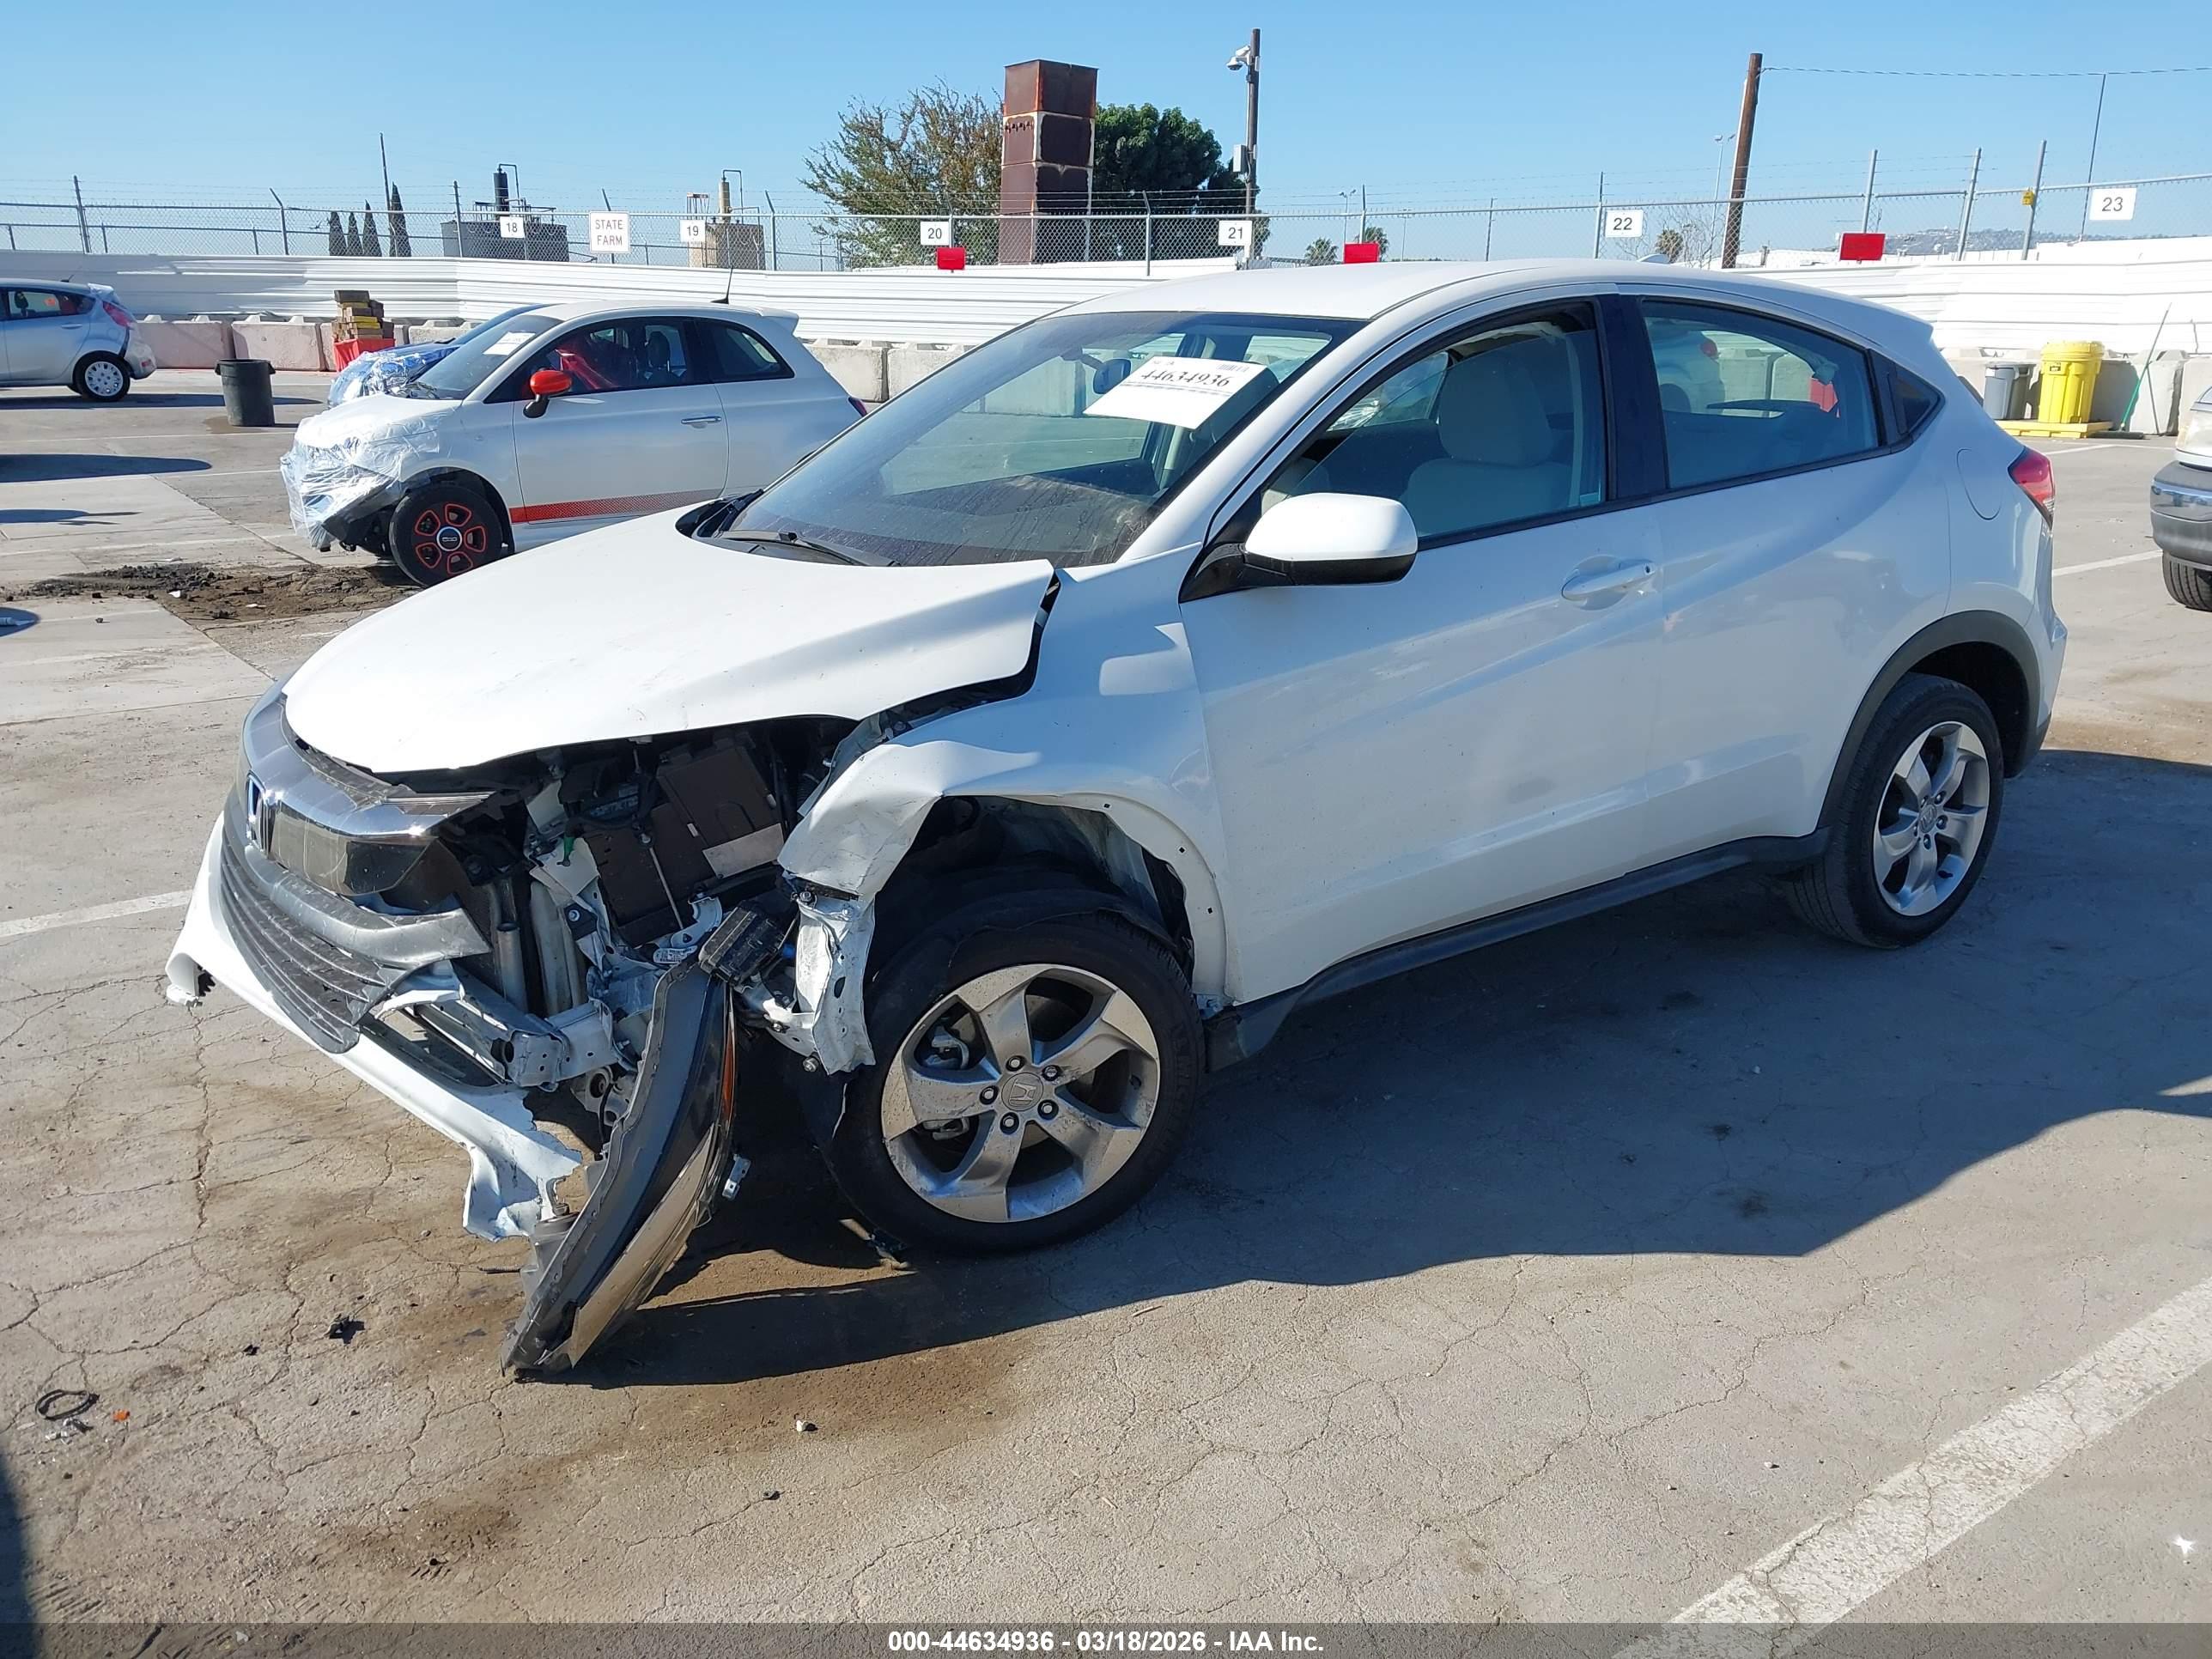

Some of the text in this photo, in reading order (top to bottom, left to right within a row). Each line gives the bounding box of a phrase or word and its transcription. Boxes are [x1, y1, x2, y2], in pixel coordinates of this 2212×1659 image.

[2101, 196, 2124, 212] 23
[505, 222, 519, 234] 18
[594, 219, 624, 231] STATE
[1613, 216, 1633, 231] 22
[686, 225, 699, 236] 19
[927, 228, 943, 240] 20
[1228, 227, 1243, 240] 21
[597, 234, 623, 246] FARM
[1140, 369, 1234, 387] 44634936
